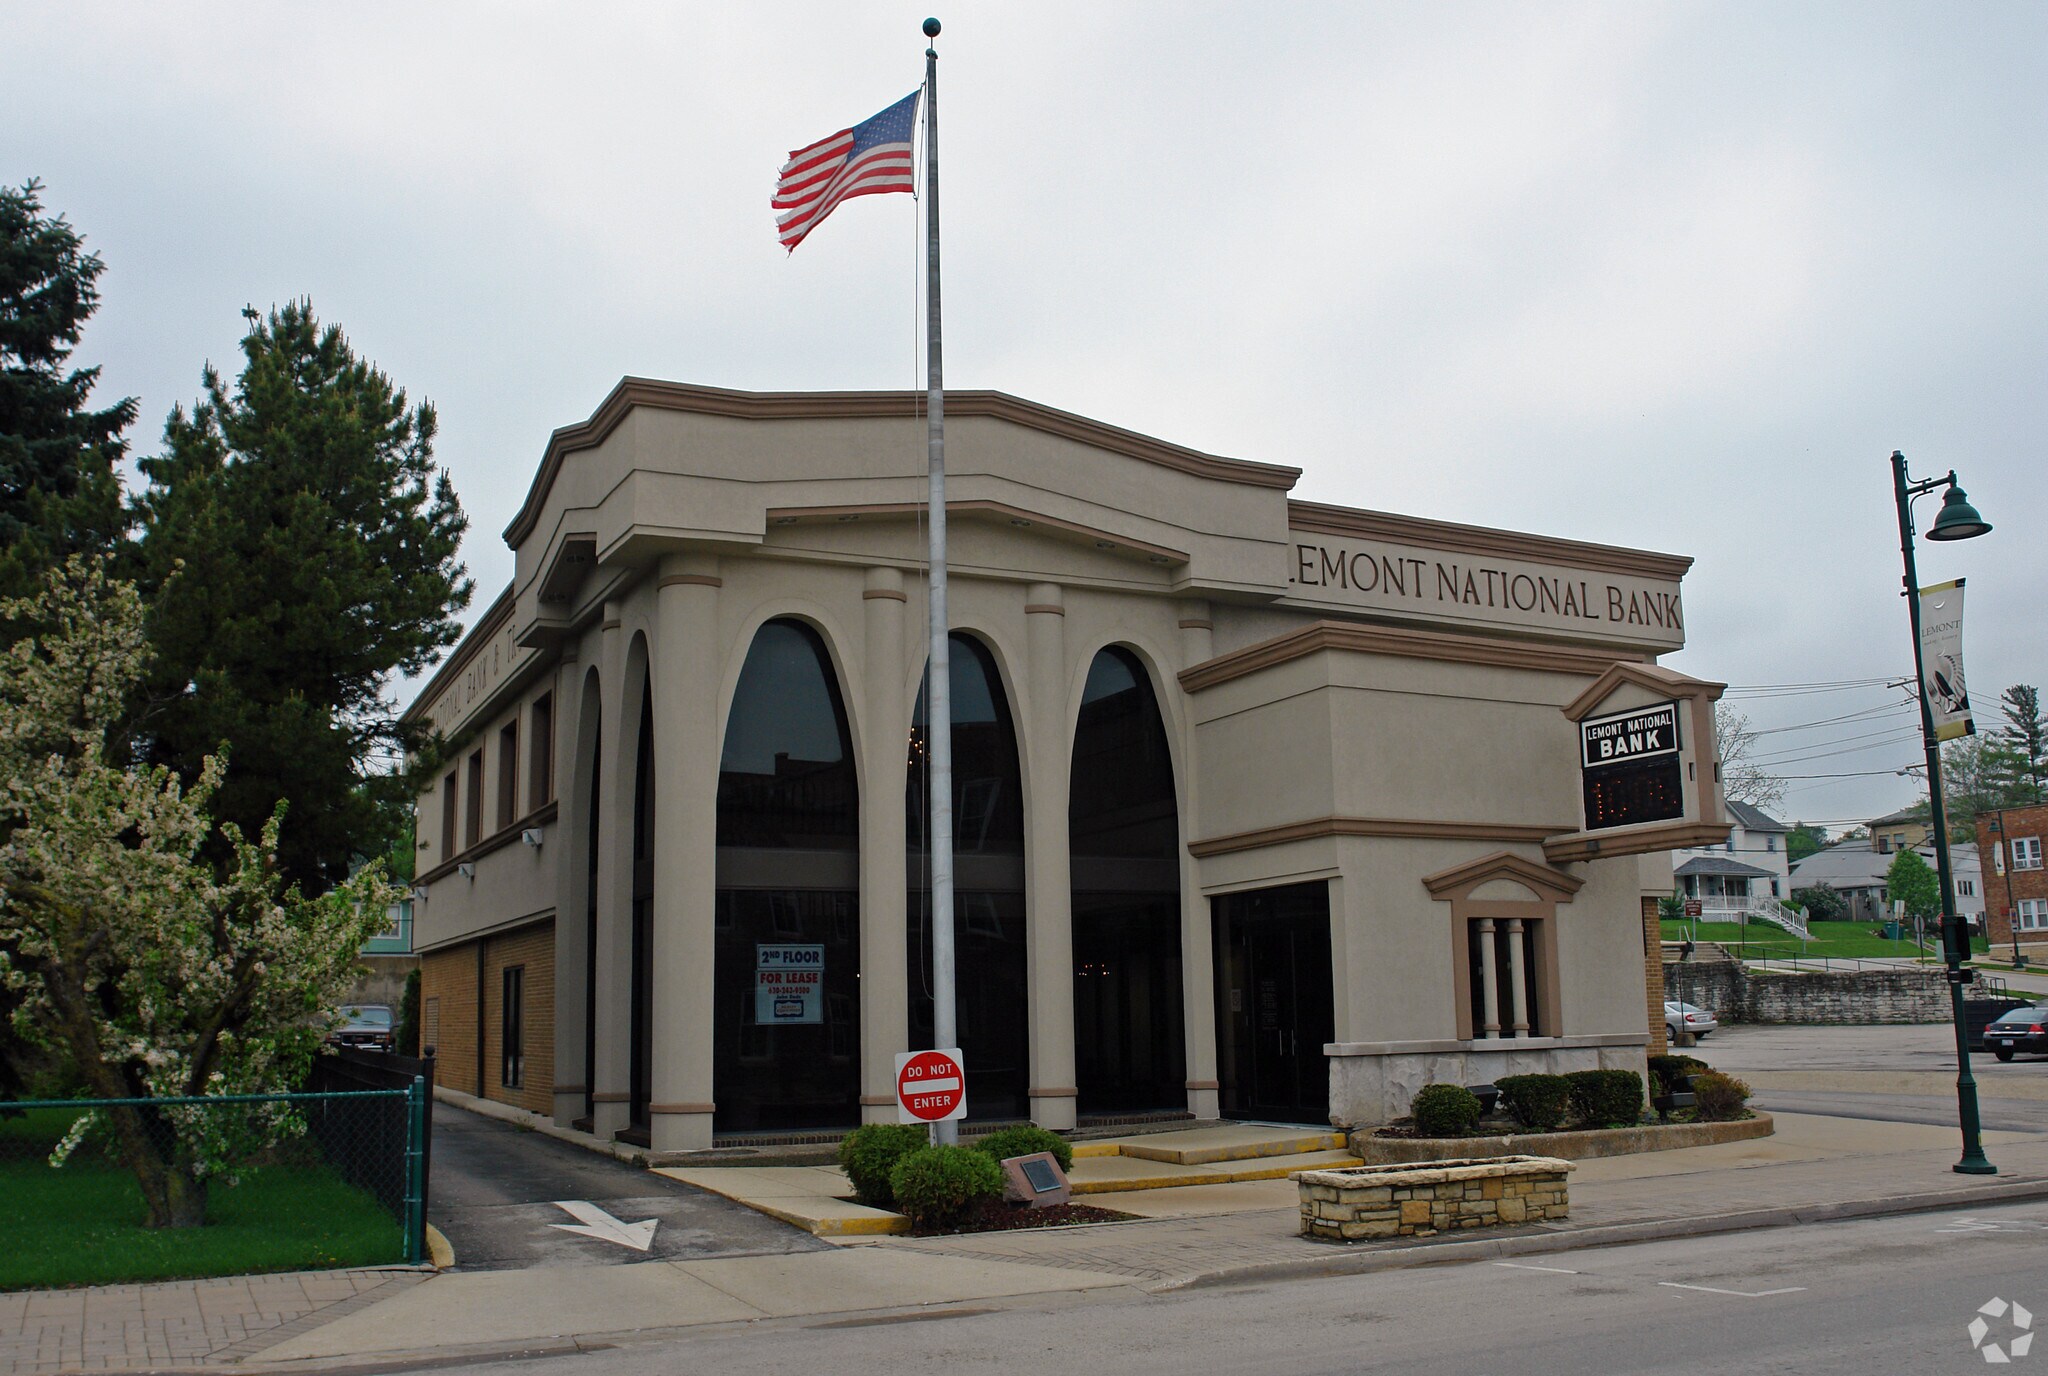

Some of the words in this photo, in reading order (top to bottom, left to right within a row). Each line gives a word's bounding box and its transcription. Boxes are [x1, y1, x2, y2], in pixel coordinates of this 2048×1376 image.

[1289, 545, 1426, 598] EMONT
[1436, 563, 1600, 620] NATIONAL
[1606, 586, 1683, 631] BANK
[1921, 620, 1961, 638] LEMONT
[466, 654, 488, 704] BANK
[1588, 723, 1623, 740] LEMONT
[1627, 712, 1672, 732] NATIONAL
[1600, 729, 1660, 758] BANK
[762, 951, 780, 963] 2ND
[783, 951, 820, 963] FLOOR
[760, 973, 782, 984] FOR
[786, 973, 818, 984] LEASE
[908, 1067, 922, 1078] DO
[930, 1064, 951, 1075] NOT
[914, 1096, 951, 1108] ENTER
